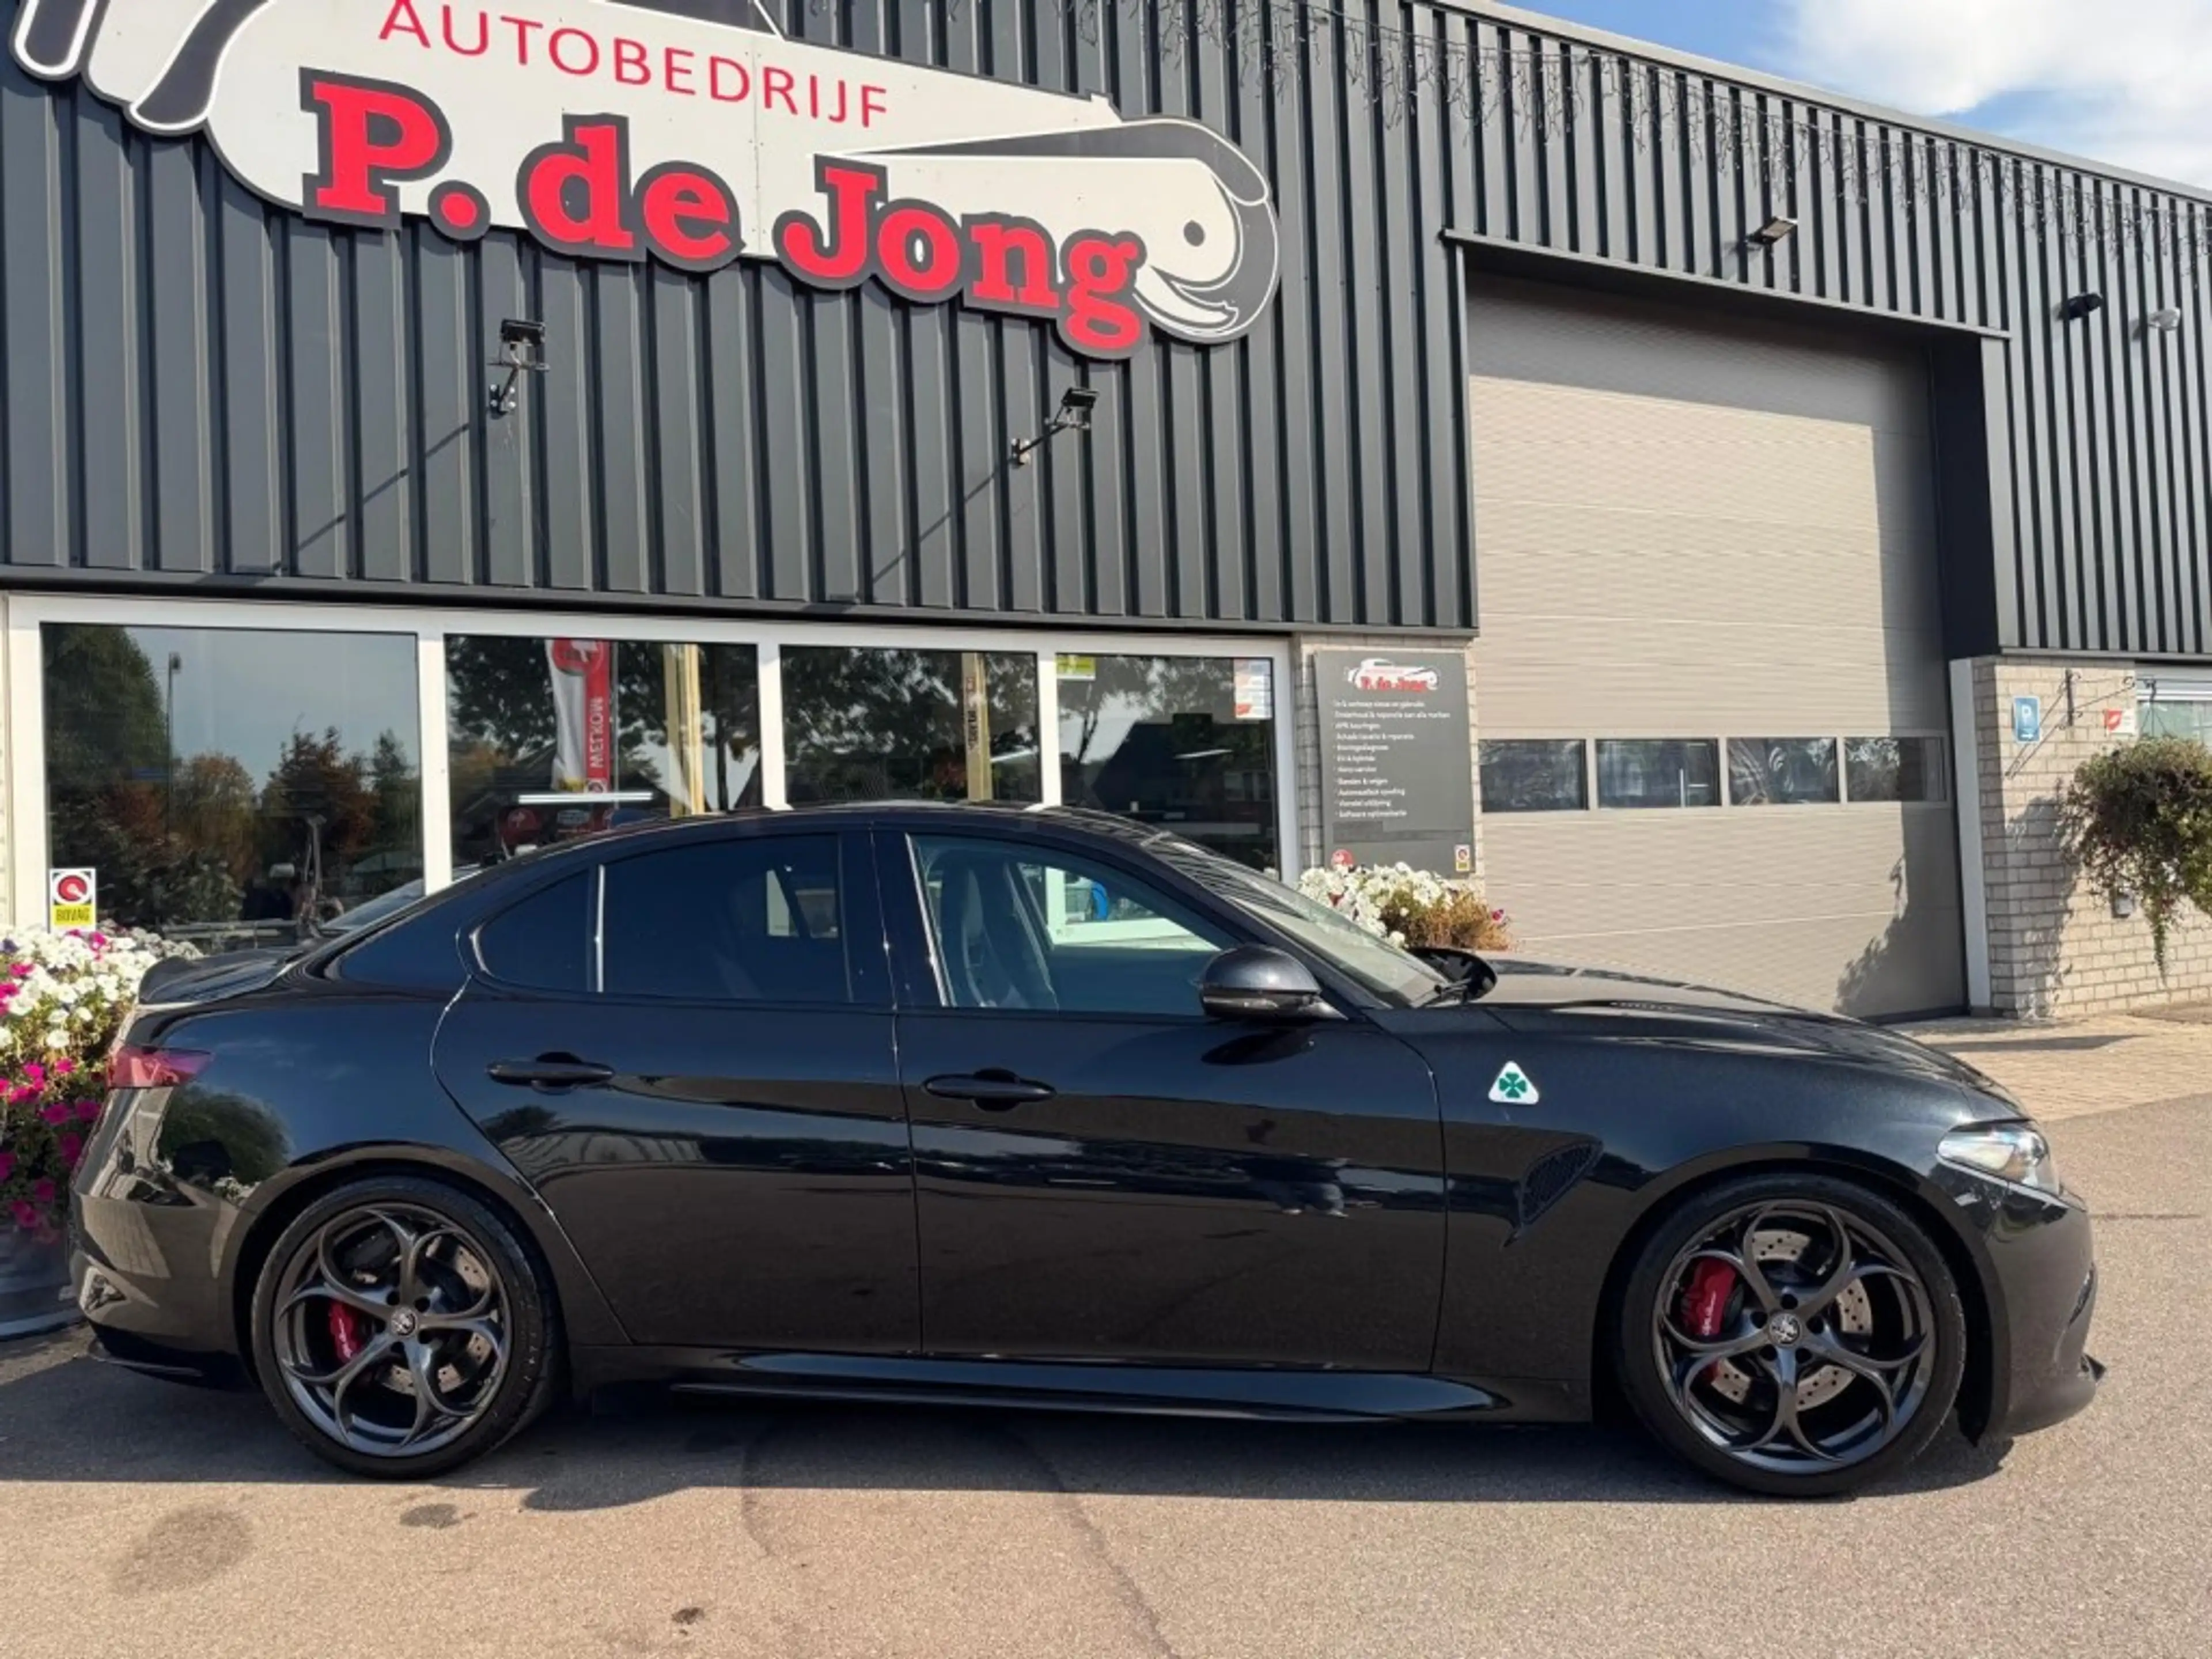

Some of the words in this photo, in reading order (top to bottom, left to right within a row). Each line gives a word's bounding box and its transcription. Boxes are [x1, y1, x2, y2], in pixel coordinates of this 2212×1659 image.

[378, 0, 887, 127] AUTOBEDRIJF
[312, 79, 478, 229] P.
[527, 124, 731, 259] de
[782, 165, 1143, 349] Jong
